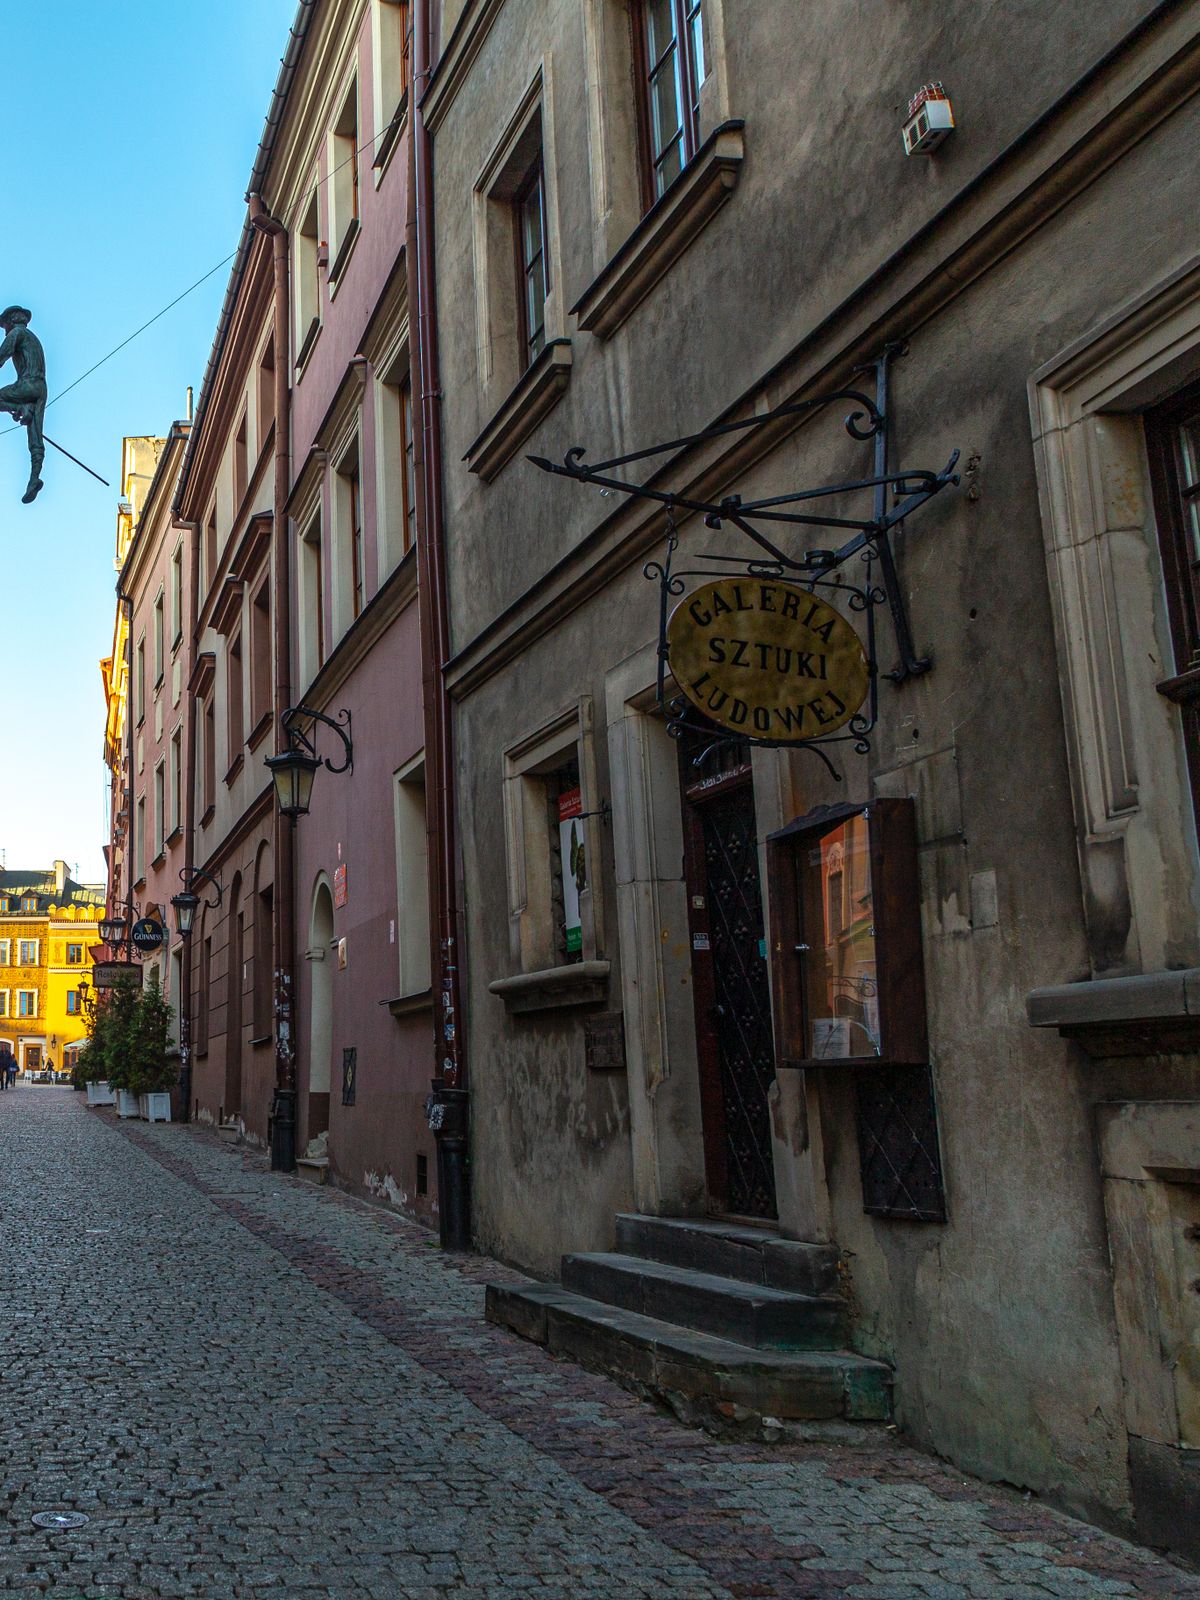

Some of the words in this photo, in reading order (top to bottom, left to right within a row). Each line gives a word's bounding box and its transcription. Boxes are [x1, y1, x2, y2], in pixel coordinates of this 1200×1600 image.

[688, 585, 836, 645] GALERIA
[708, 637, 827, 680] SZTUKI
[690, 671, 847, 733] LUDOWEJ
[134, 932, 162, 941] GUINNESS
